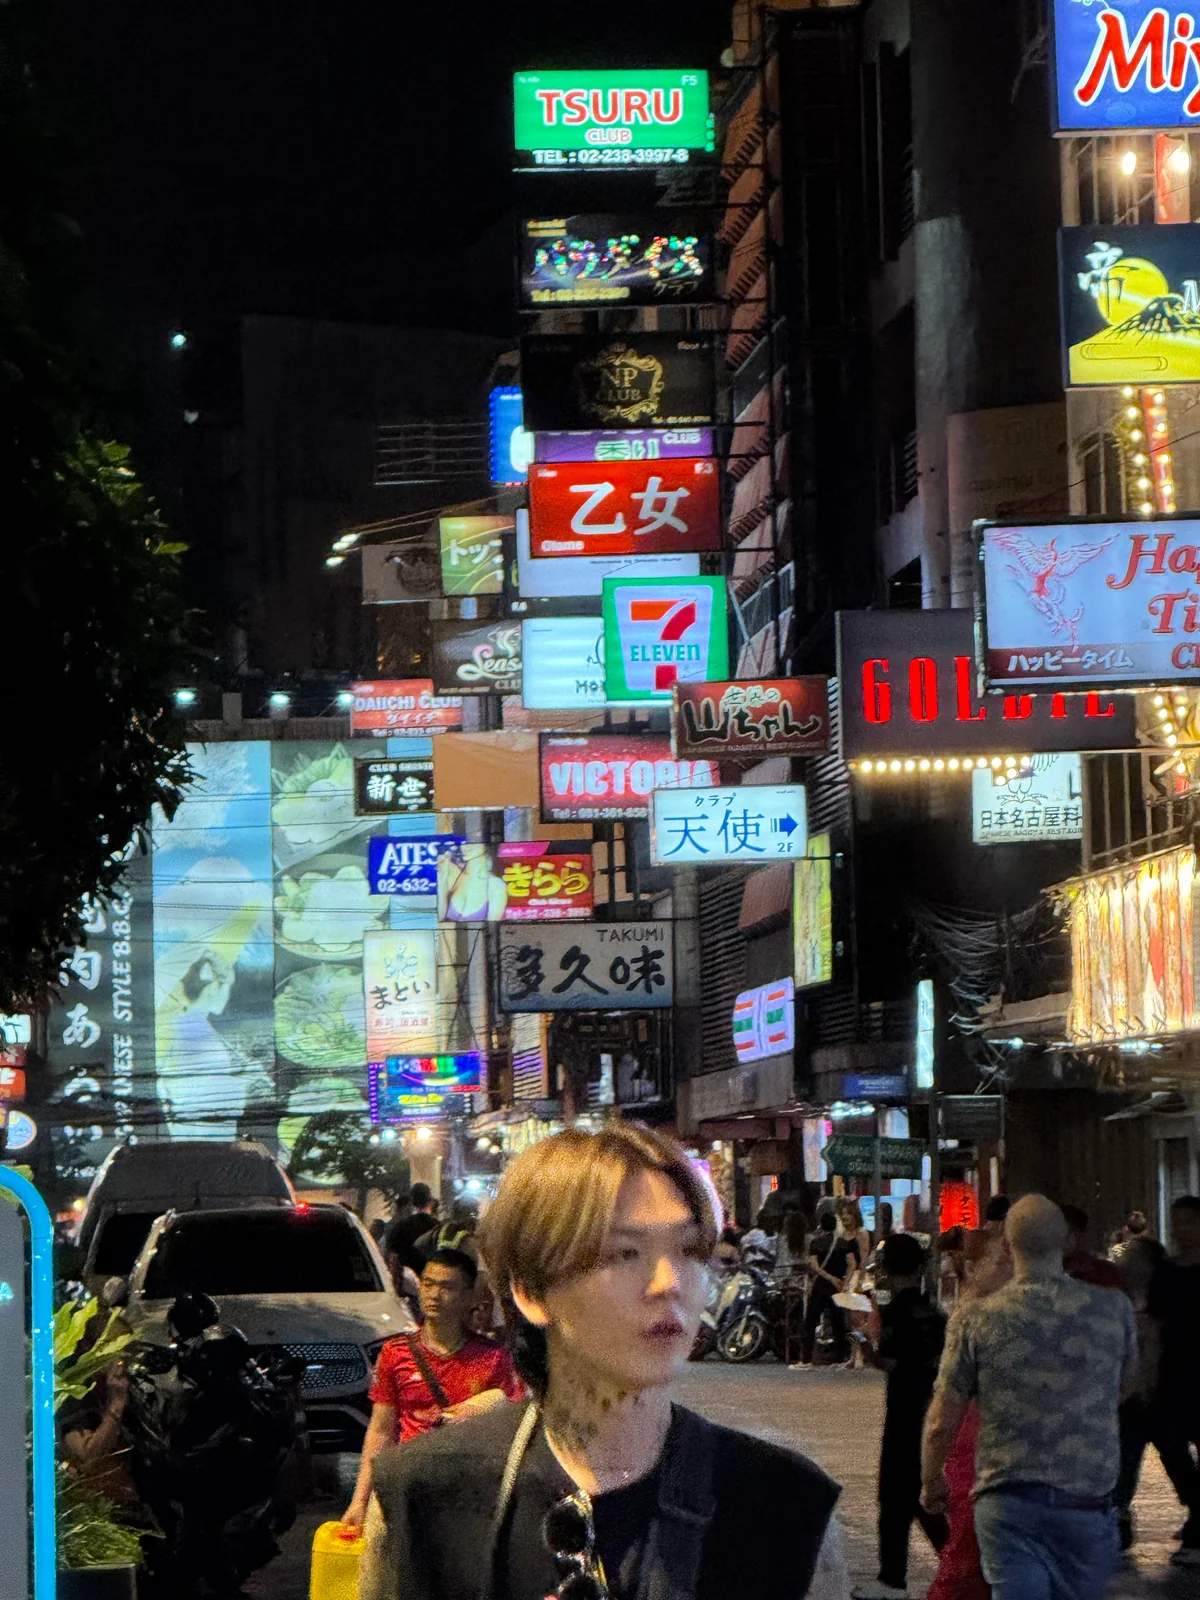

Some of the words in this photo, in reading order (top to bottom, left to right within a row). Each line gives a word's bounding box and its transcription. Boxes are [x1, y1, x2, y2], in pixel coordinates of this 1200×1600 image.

[681, 75, 698, 86] F5
[536, 88, 683, 125] TSURU
[585, 128, 632, 144] CLUB
[663, 432, 701, 445] CLUB
[694, 463, 713, 474] F3
[569, 476, 691, 536] 乙女
[1106, 532, 1200, 589] Ha
[630, 600, 697, 691] 7
[1007, 649, 1134, 672] ハッピータイム
[354, 696, 416, 712] DAIICHI
[419, 693, 463, 710] CLUB
[387, 712, 438, 725] ダイイチ
[683, 698, 822, 744] 山ちゃん
[548, 760, 713, 795] VICTORIA
[695, 792, 737, 807] クラブ
[663, 809, 766, 857] 天使
[777, 842, 794, 853] 2F
[502, 861, 589, 897] きらら
[596, 928, 664, 943] TAKUMI
[507, 944, 665, 1001] 多久味
[112, 959, 133, 1021] STYLE
[369, 980, 431, 1010] まとい
